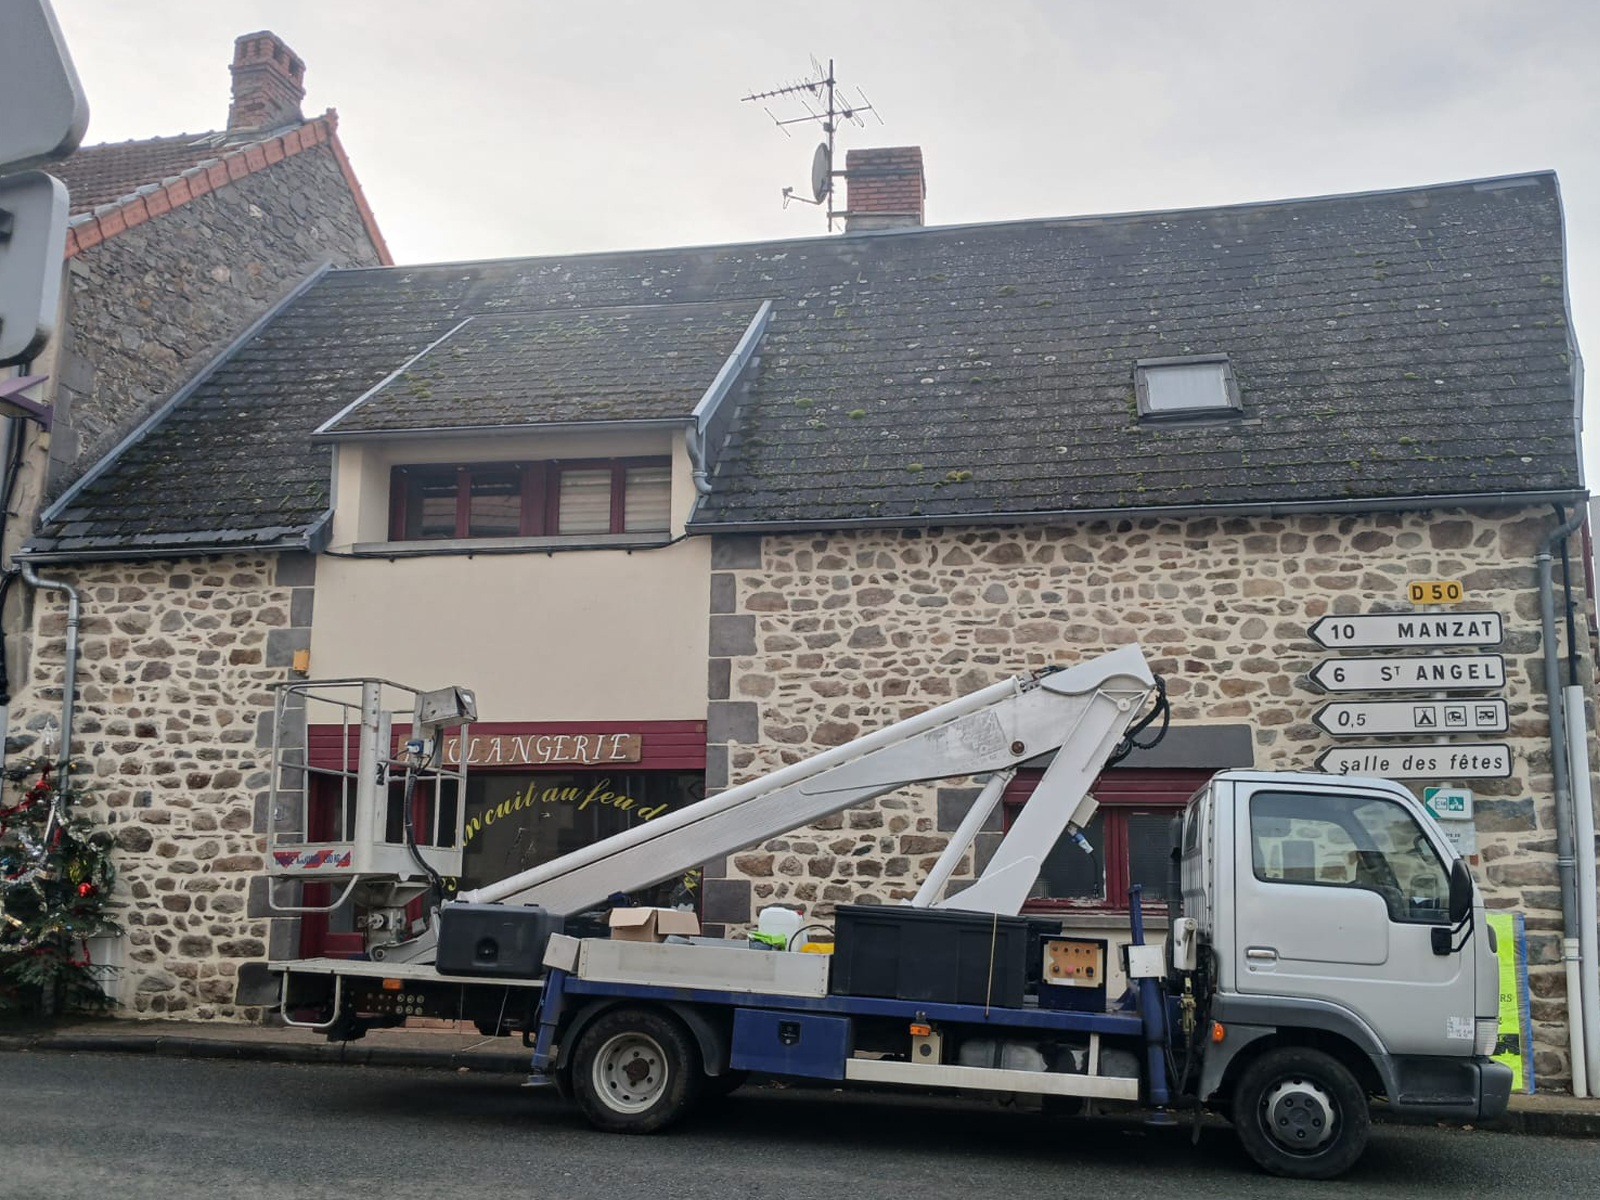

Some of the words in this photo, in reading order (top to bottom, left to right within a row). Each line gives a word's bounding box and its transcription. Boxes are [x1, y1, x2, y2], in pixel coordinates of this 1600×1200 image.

[1412, 585, 1424, 601] D
[1431, 584, 1459, 600] 50
[1330, 624, 1356, 640] 10
[1398, 620, 1492, 639] MANZAT
[1333, 667, 1346, 683] 6
[1416, 663, 1496, 681] ANGEL
[1337, 710, 1367, 728] 0,5
[1339, 756, 1391, 773] salle
[1401, 754, 1438, 771] des
[1449, 753, 1503, 771] fêtes
[484, 780, 540, 827] cuit
[541, 786, 584, 803] au
[577, 778, 638, 812] feu
